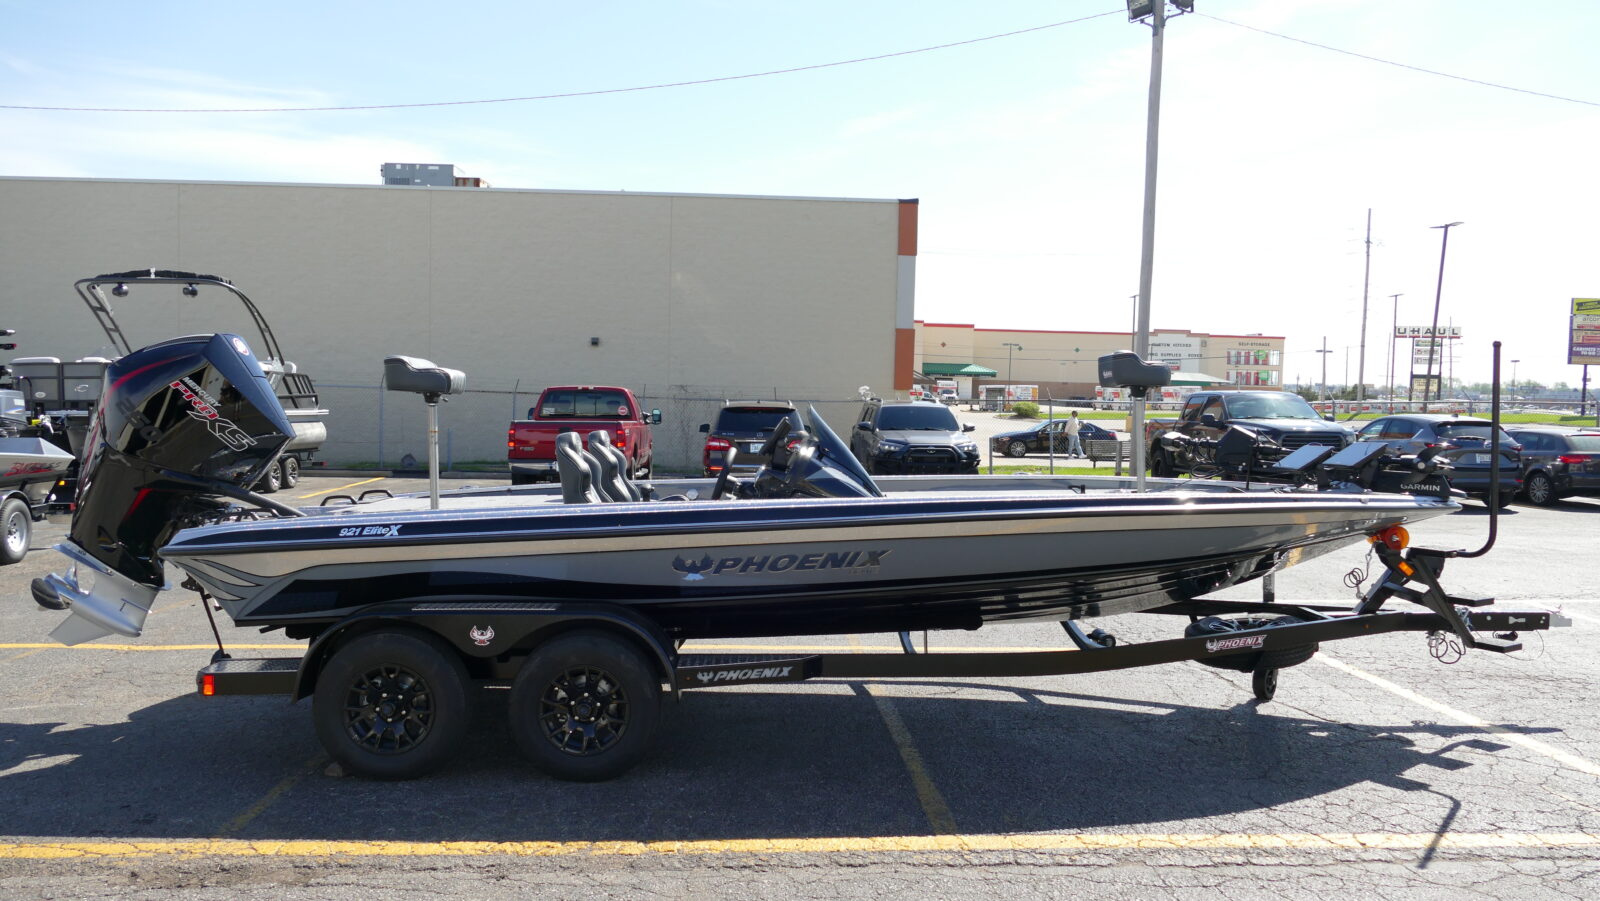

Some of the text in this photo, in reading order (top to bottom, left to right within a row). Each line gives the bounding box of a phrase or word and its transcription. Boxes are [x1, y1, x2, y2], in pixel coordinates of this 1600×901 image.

[169, 380, 219, 420] PRO
[182, 376, 222, 407] MERCURY
[186, 410, 258, 452] XS
[1400, 483, 1441, 492] GARMIN
[338, 527, 361, 537] 921
[711, 549, 894, 575] PHOENIX
[1218, 634, 1268, 650] PHOENIX
[713, 666, 793, 682] PHOENIX
